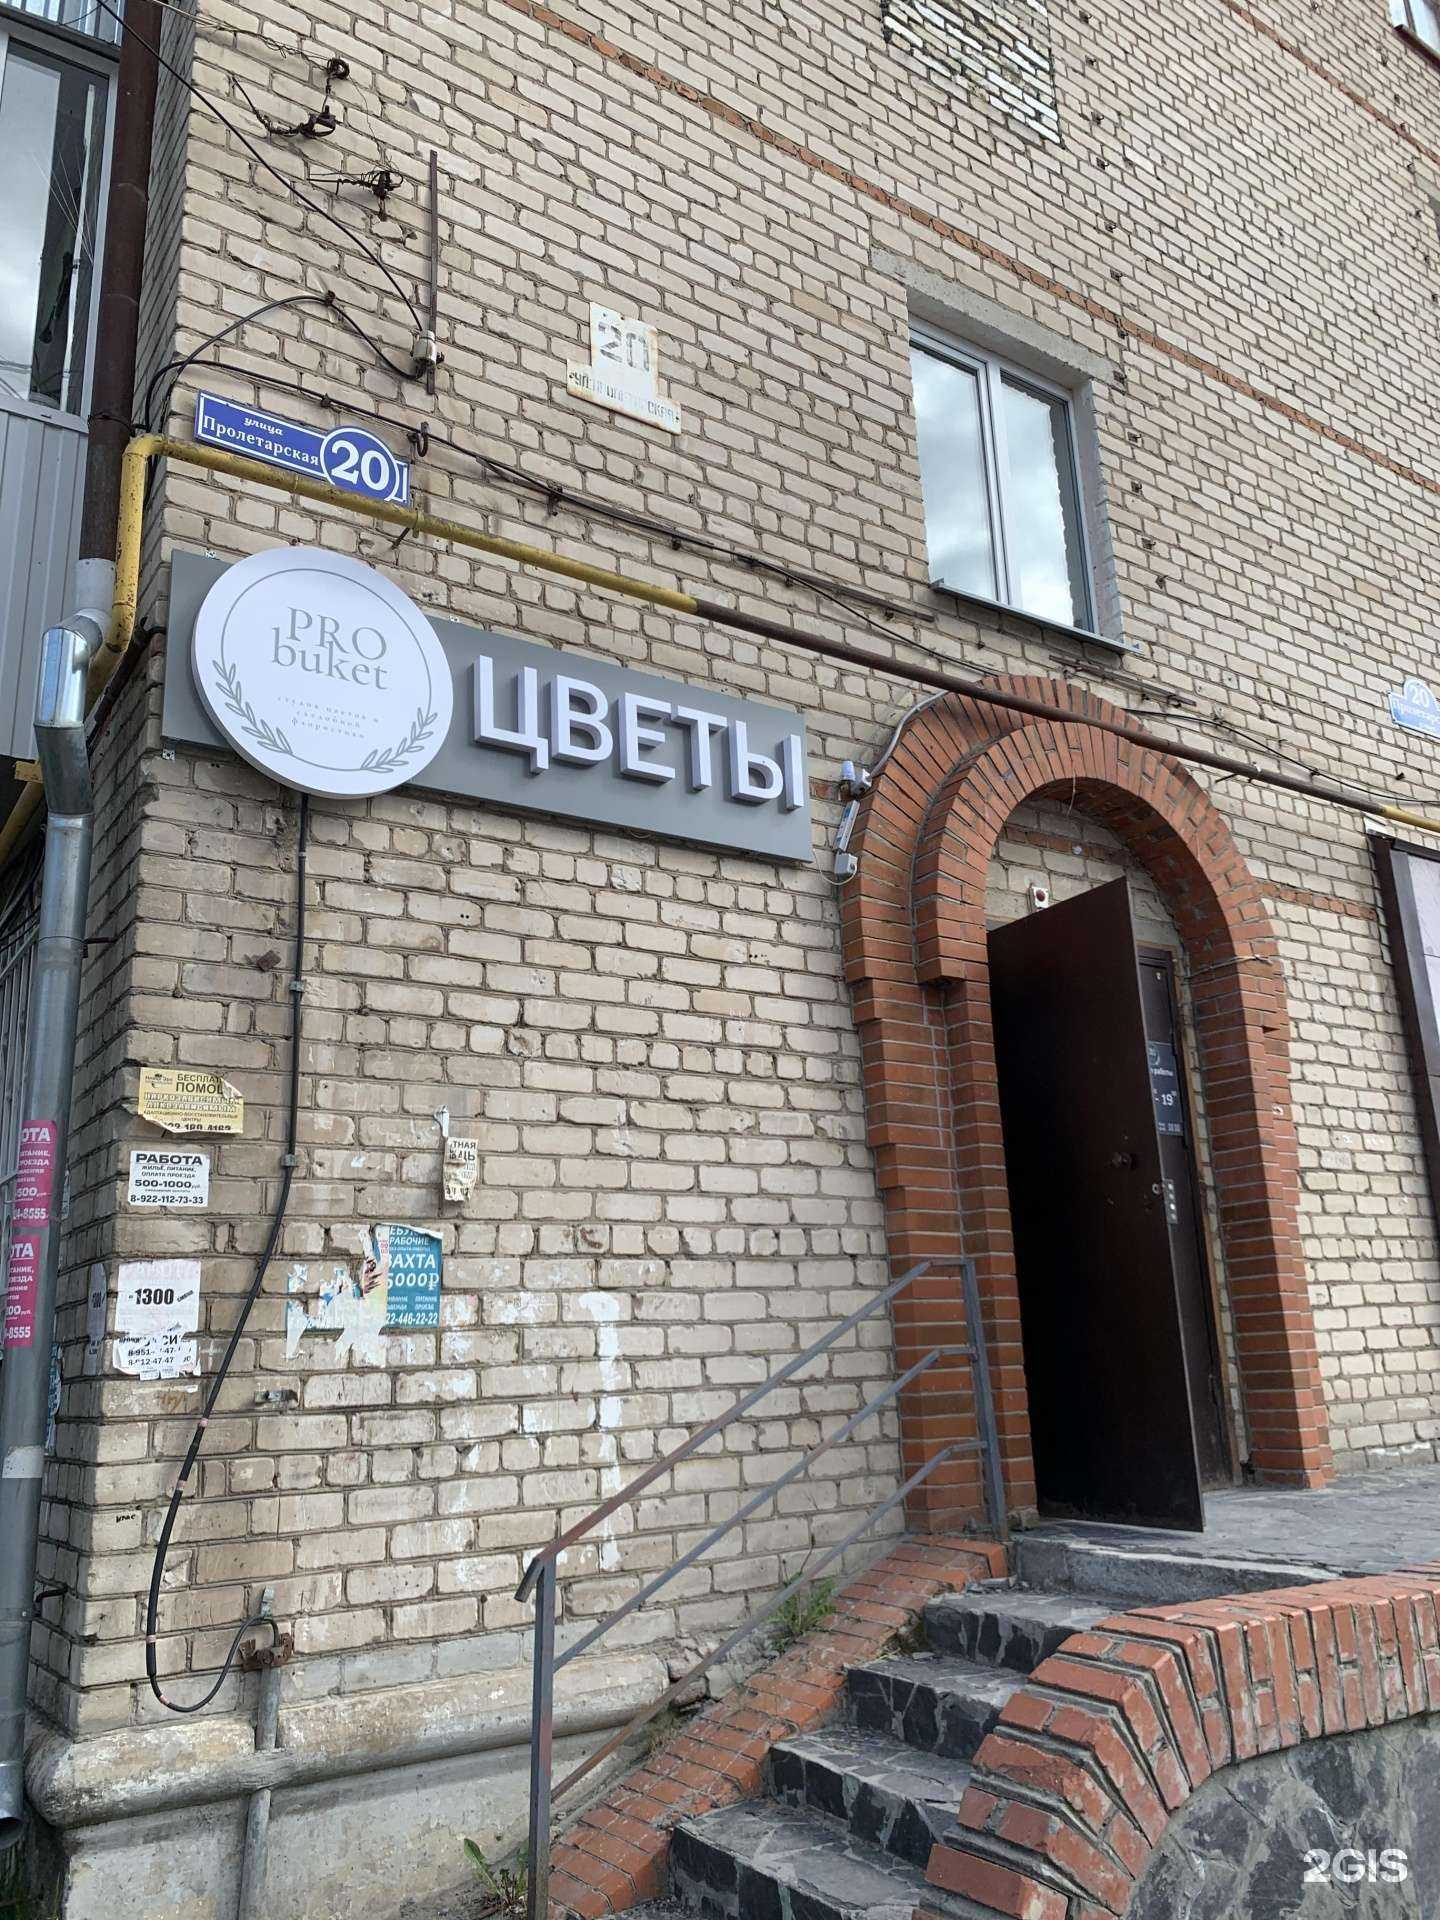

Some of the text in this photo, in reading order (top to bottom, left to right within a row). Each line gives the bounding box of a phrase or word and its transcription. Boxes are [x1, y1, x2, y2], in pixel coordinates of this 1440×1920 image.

[243, 416, 284, 436] улица
[203, 415, 319, 466] Пролетарская
[330, 439, 390, 491] 20
[286, 606, 387, 660] PRO
[271, 627, 389, 690] buket
[1409, 686, 1430, 708] 20
[473, 654, 805, 812] ЦВЕТЫ
[1161, 1093, 1174, 1106] 19
[136, 1153, 203, 1166] РАБОТА
[135, 1180, 192, 1188] 500-1000
[130, 1194, 204, 1205] 8-922-112-73-33
[389, 1236, 430, 1246] РАБОЧИЕ
